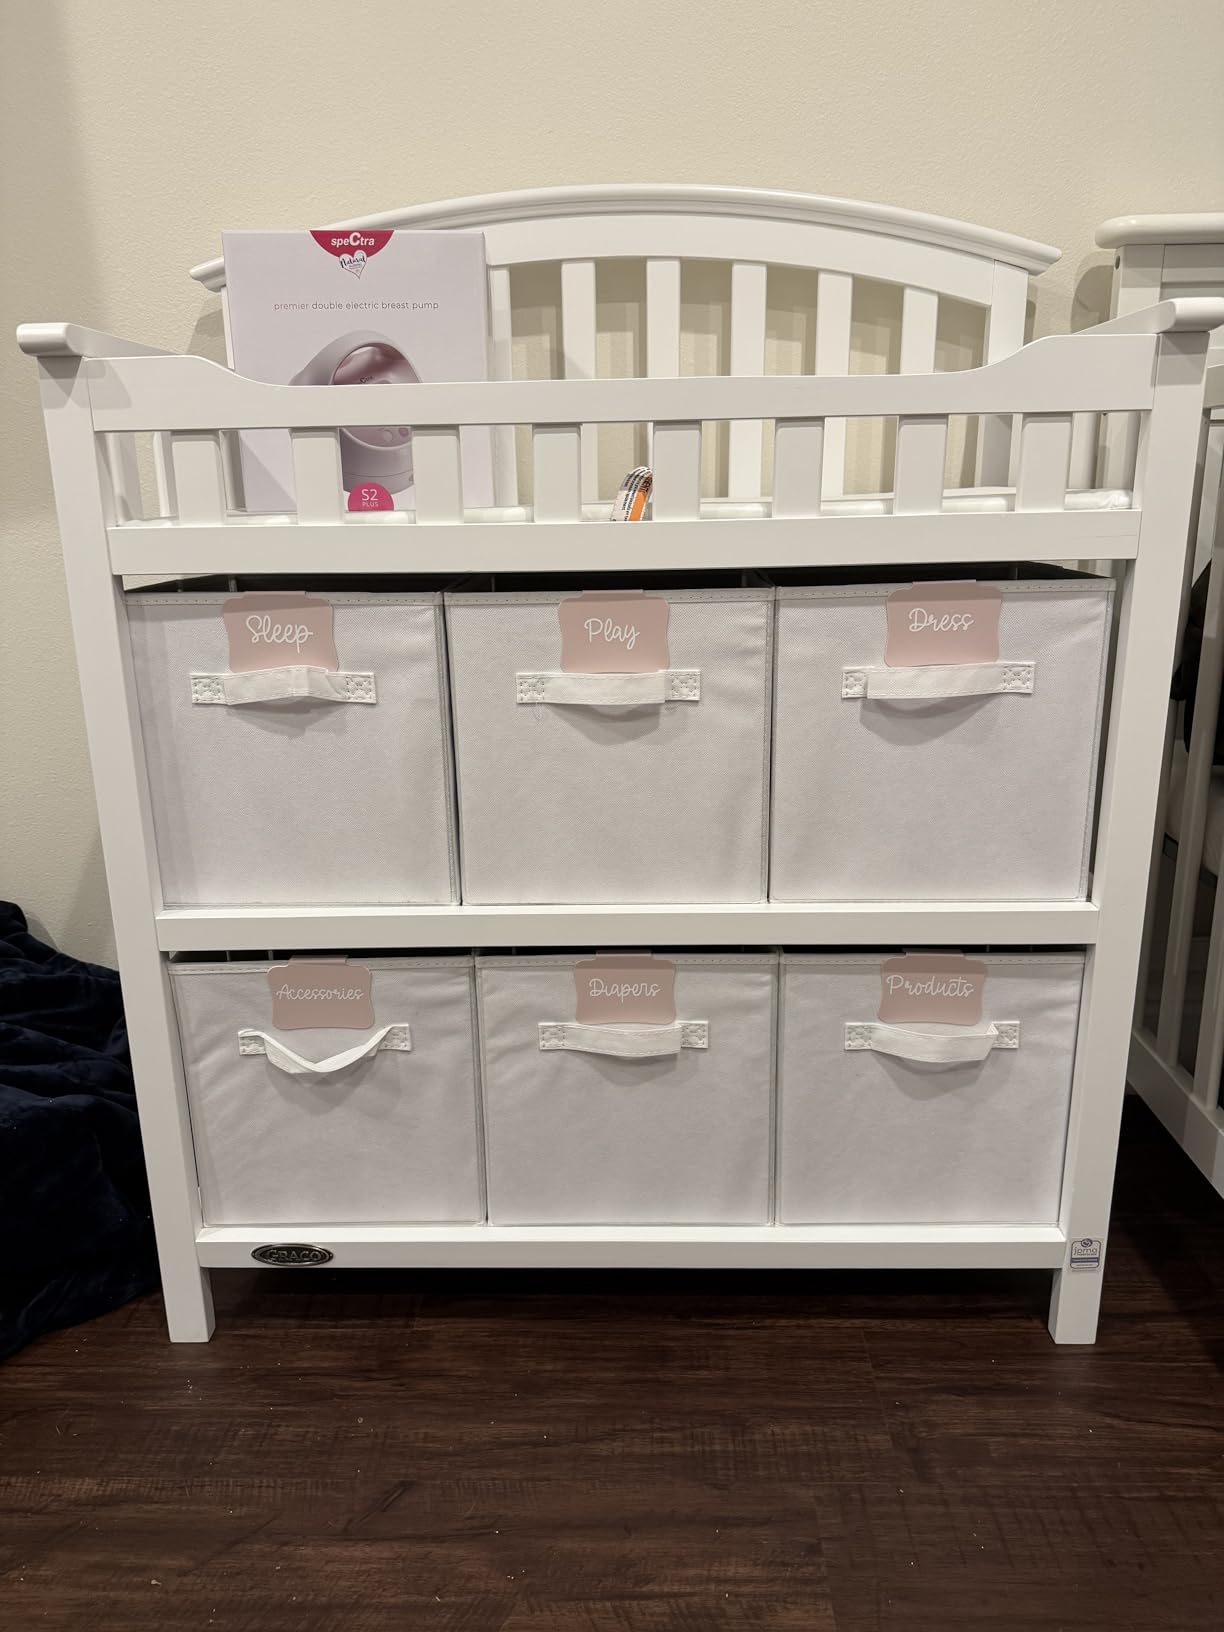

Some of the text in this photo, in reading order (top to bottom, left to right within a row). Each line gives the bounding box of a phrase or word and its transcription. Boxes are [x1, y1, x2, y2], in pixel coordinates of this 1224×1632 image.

[330, 232, 375, 248] speCtra
[273, 301, 439, 311] premier double electric breast pump
[361, 488, 379, 501] S2
[908, 607, 975, 632] Dress
[246, 615, 314, 654] Sleep
[584, 618, 640, 650] Play
[276, 983, 364, 1000] Accessories
[886, 974, 975, 998] Products
[267, 1249, 322, 1261] GRACO
